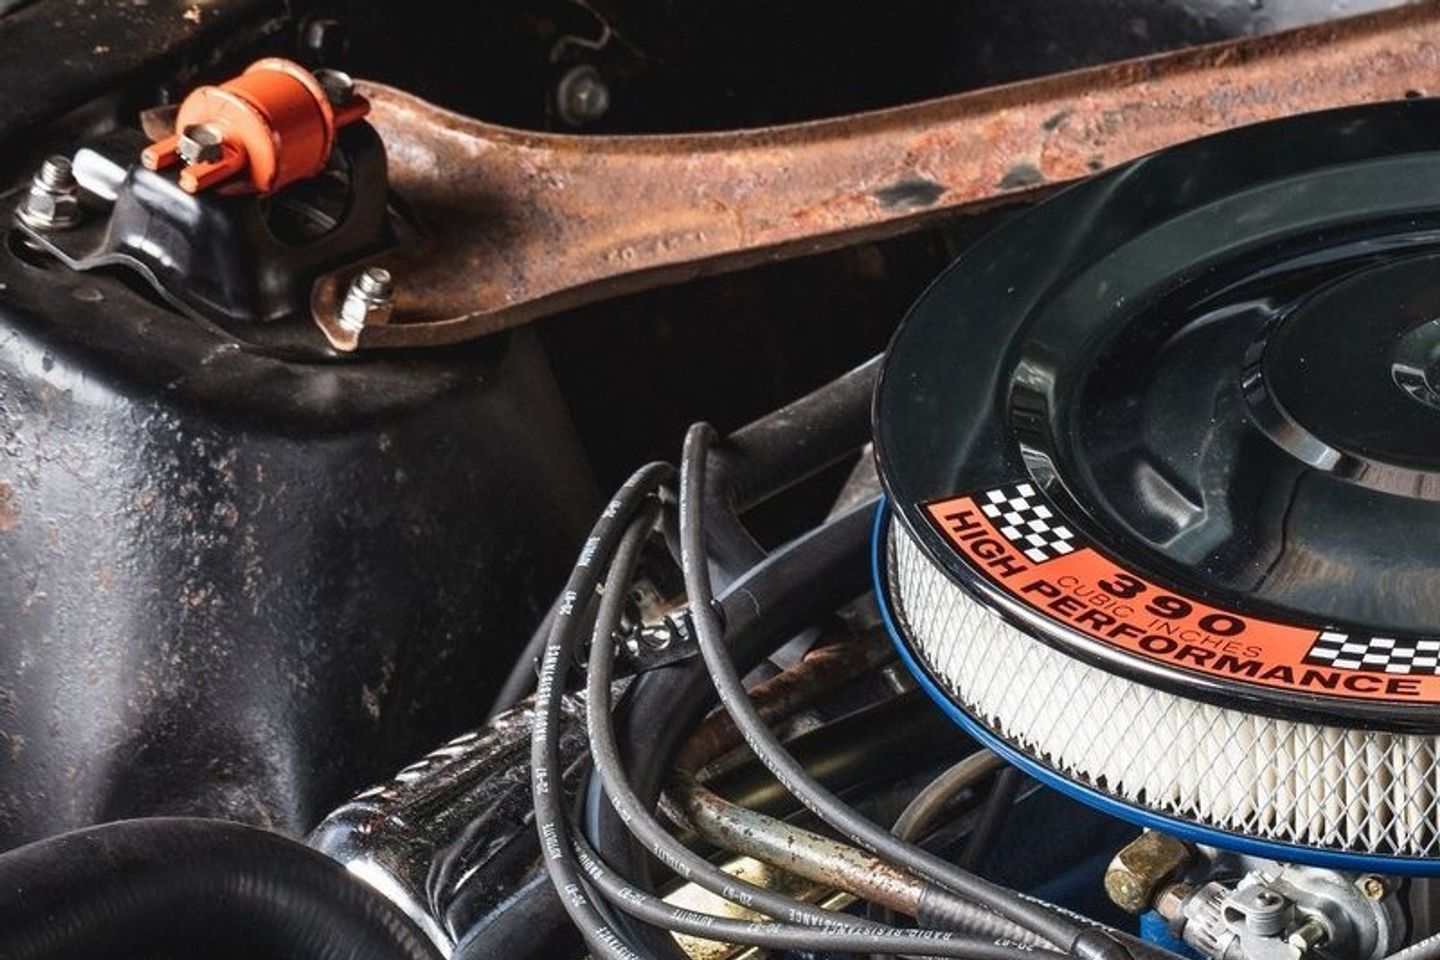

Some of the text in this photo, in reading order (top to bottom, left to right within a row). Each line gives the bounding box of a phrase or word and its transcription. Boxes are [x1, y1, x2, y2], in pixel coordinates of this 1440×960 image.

[944, 509, 1423, 697] HIGH PERFORMANCE
[1057, 575, 1264, 659] CUBIC INCHES
[1099, 572, 1247, 638] 390
